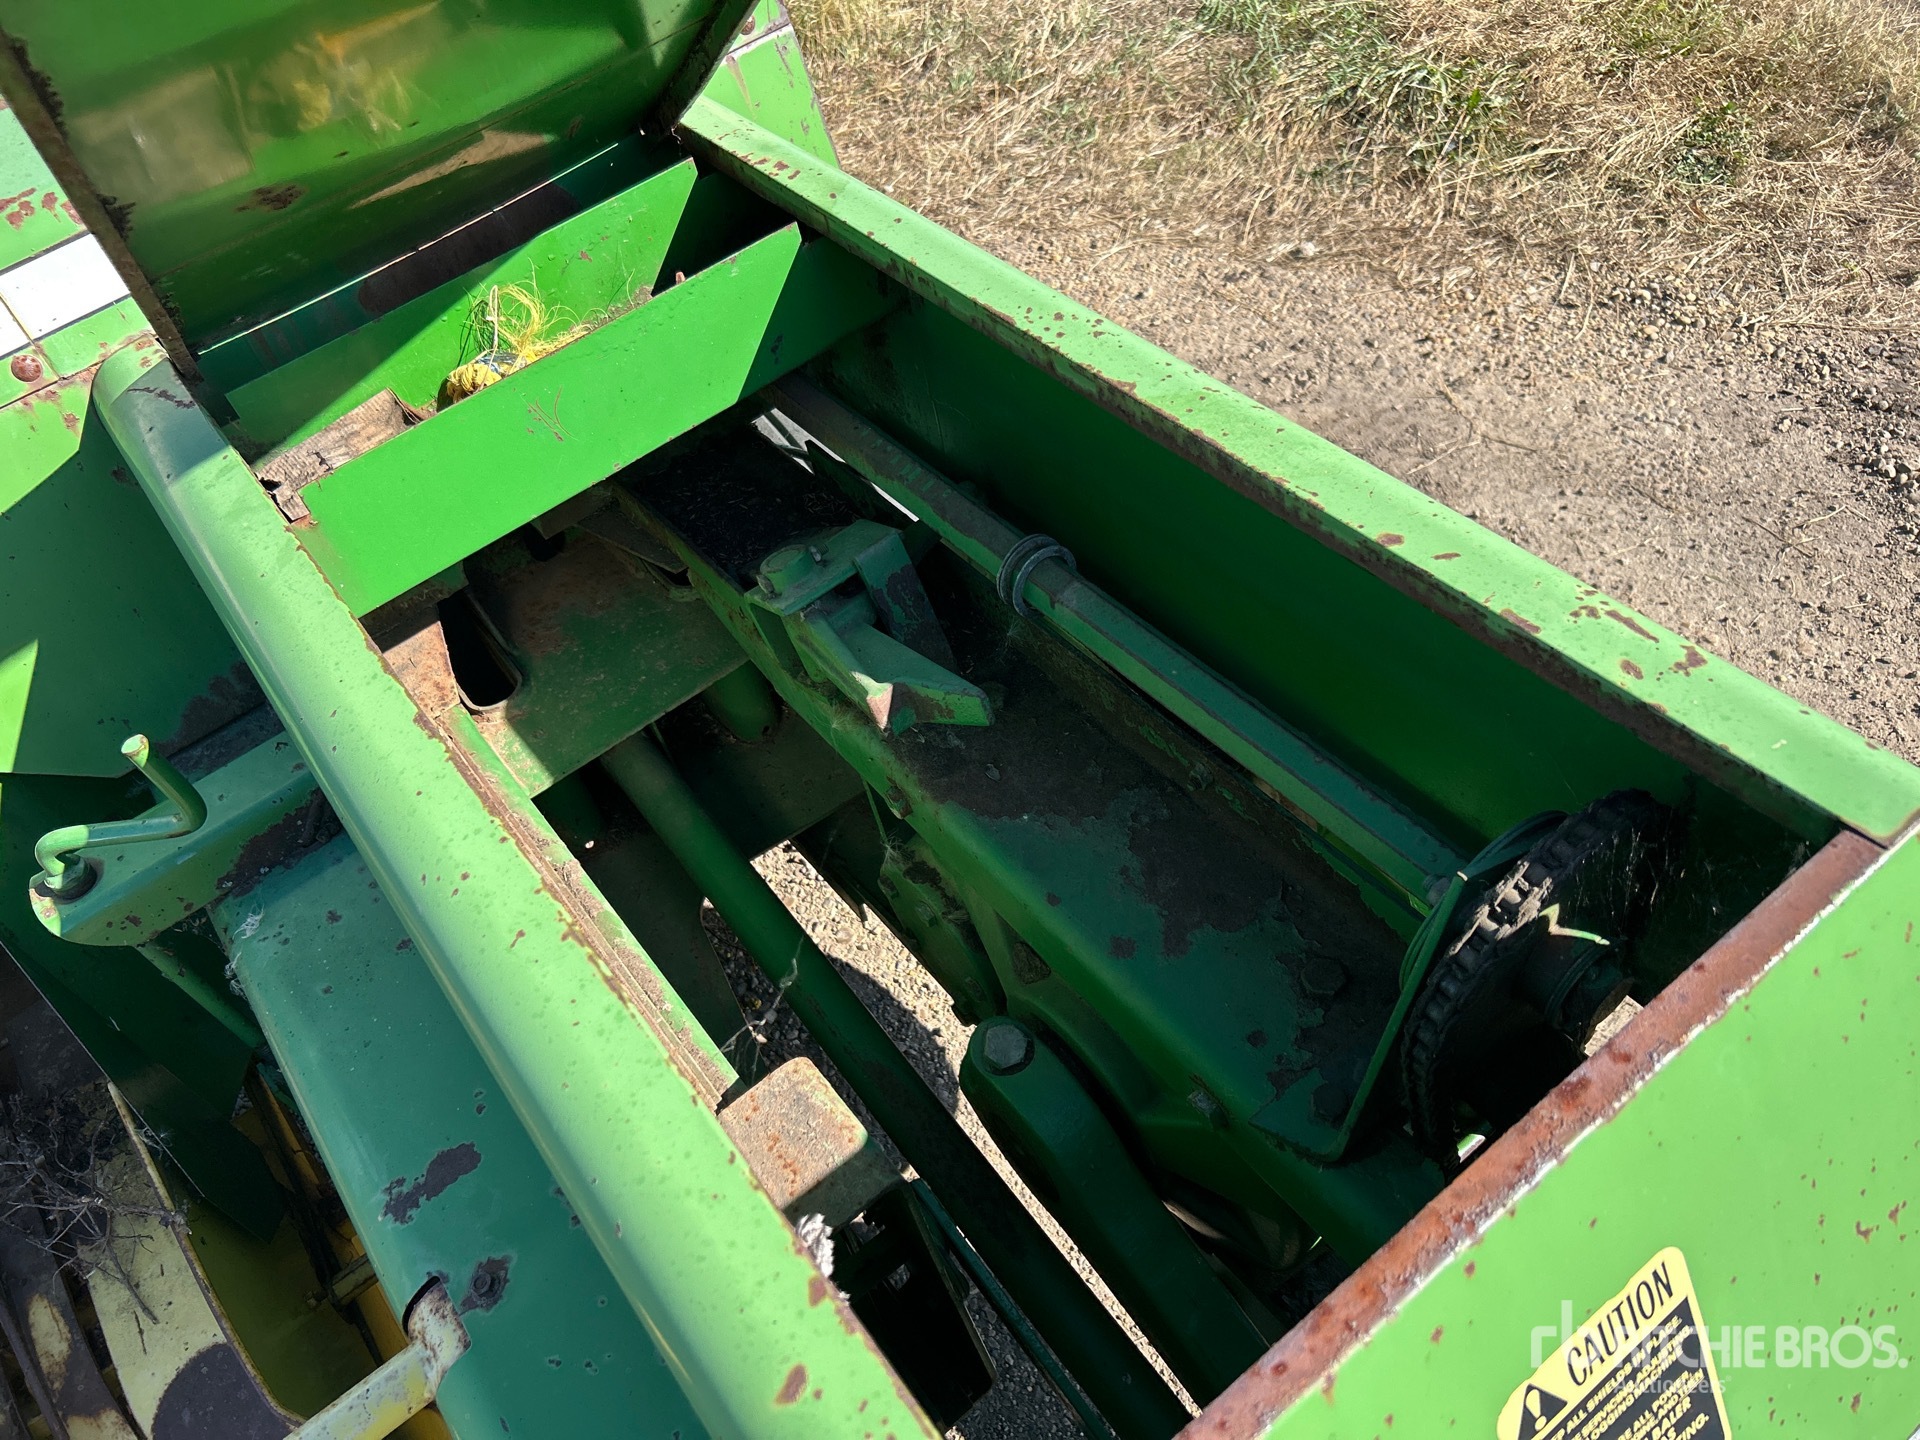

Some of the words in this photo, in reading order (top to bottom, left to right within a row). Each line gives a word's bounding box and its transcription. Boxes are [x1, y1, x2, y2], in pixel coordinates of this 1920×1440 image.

[1566, 1261, 1673, 1387] CAUTION
[1566, 1409, 1588, 1434] ALL
[1586, 1362, 1633, 1412] SHIELDS
[1631, 1348, 1646, 1367] IN
[1633, 1343, 1684, 1400] MACHINE
[1658, 1394, 1679, 1420] AND
[1678, 1367, 1704, 1399] THEN
[1633, 1409, 1653, 1434] ALL
[1651, 1396, 1692, 1440] BALER
